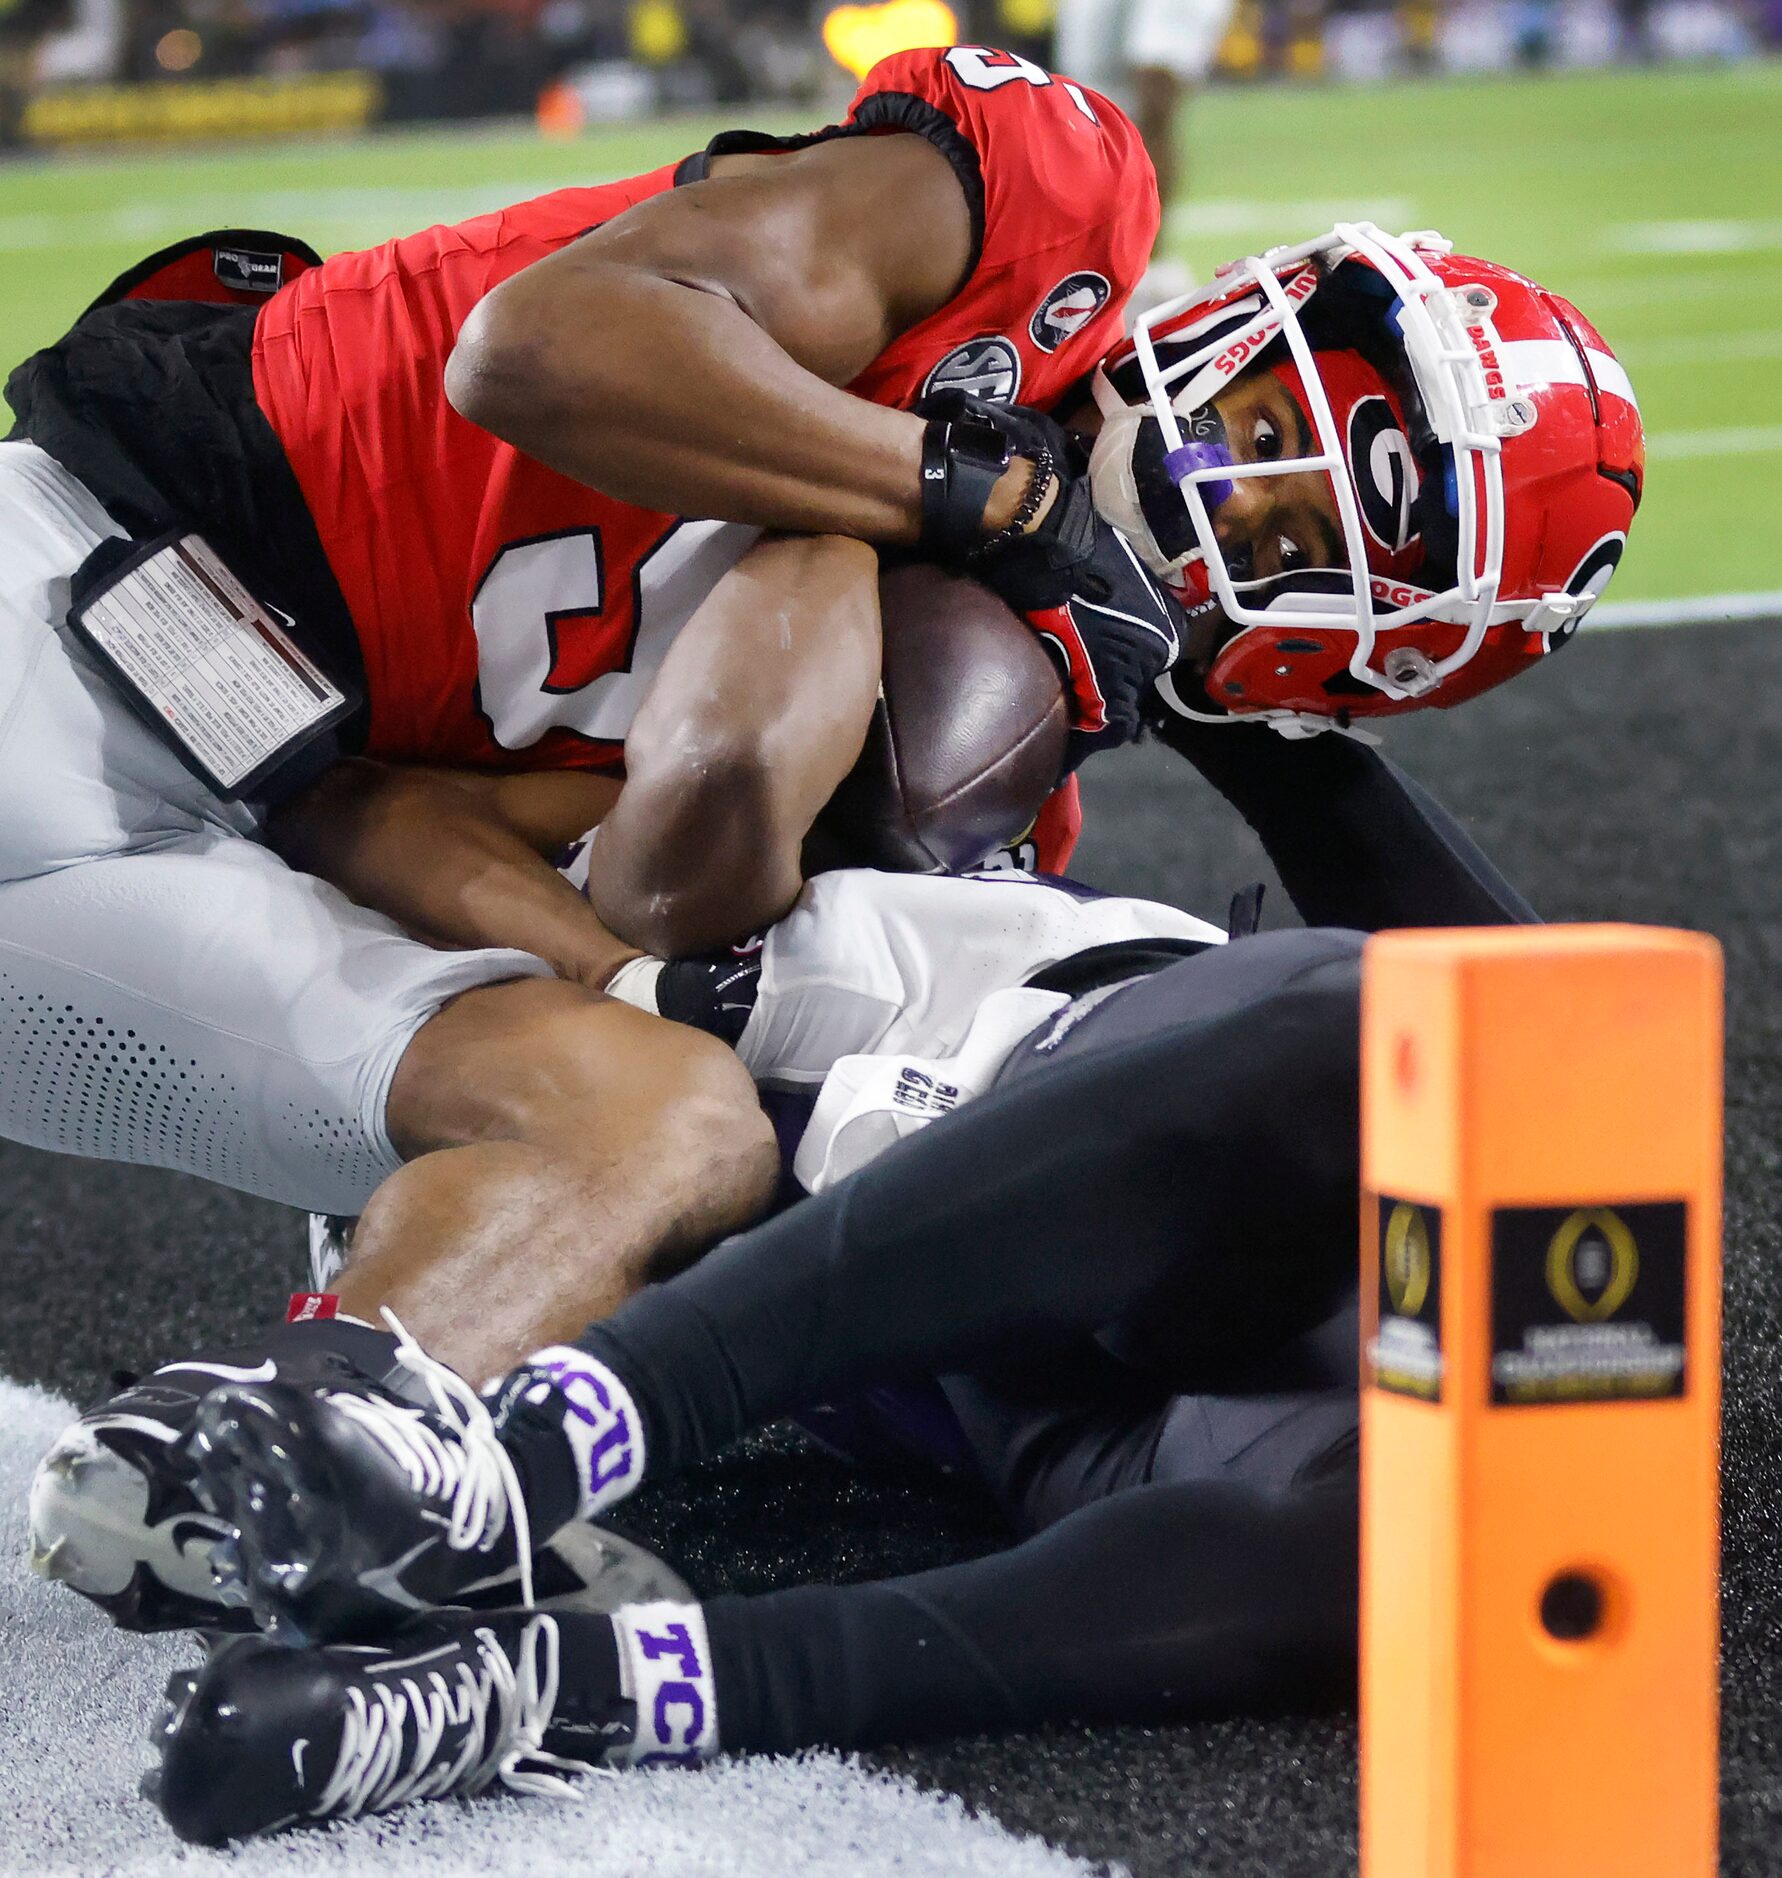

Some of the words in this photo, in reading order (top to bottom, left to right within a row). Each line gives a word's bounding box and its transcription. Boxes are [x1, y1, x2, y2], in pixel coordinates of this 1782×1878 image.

[931, 345, 1014, 402] SE
[1466, 325, 1506, 400] DAWGS
[924, 468, 945, 480] 3
[549, 1361, 632, 1494] CU
